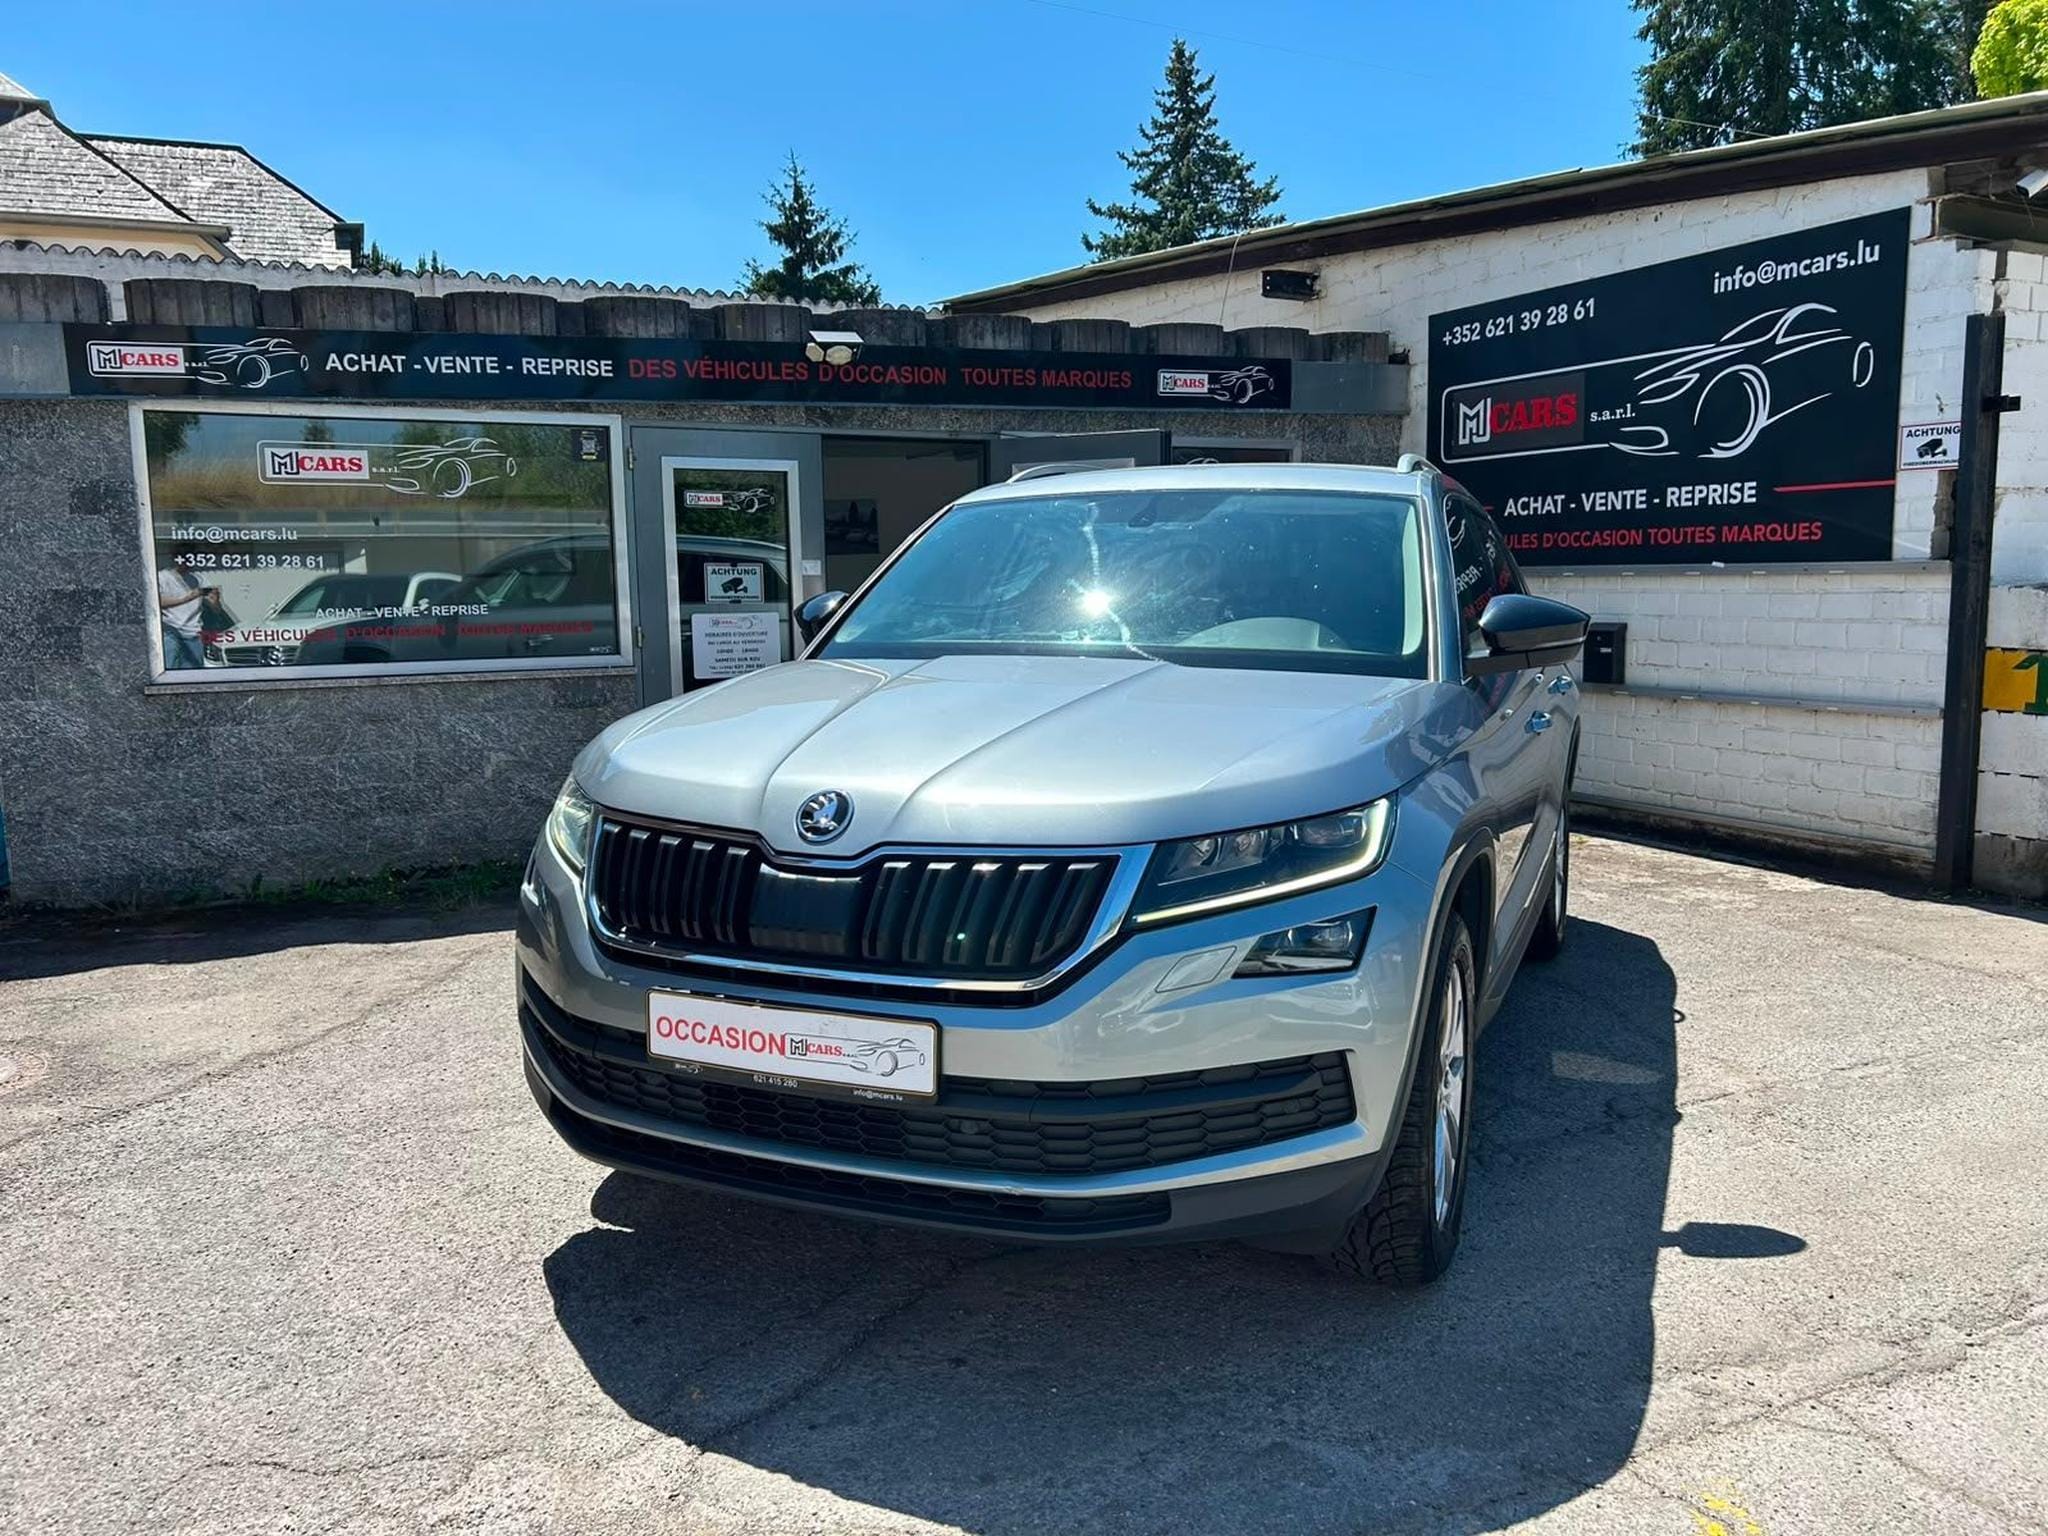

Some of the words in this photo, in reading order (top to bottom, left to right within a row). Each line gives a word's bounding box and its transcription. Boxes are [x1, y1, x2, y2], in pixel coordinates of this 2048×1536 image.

[1713, 239, 1880, 294] info@mcars.lu
[1443, 322, 1481, 346] +352
[1485, 314, 1514, 338] 621
[1520, 309, 1542, 331] 39
[1546, 303, 1568, 326] 28
[1573, 297, 1595, 320] 61
[325, 352, 406, 373] ACHAT
[521, 356, 614, 377] REPRISE
[628, 359, 677, 379] DES
[684, 354, 809, 381] VÉHICULES
[818, 363, 947, 385] D'OCCASION
[961, 367, 1037, 387] TOUTES
[1041, 370, 1133, 388] MARQUES
[1589, 403, 1636, 422] s.a.r.l.
[1906, 425, 1961, 439] ACHTUNG
[1504, 494, 1565, 517] ACHAT
[1581, 488, 1648, 512] VENTE
[1666, 481, 1758, 508] REPRISE
[171, 526, 298, 543] info@mcars.lu
[1542, 528, 1643, 549] D'OCCASION
[1649, 525, 1716, 545] TOUTES
[1721, 521, 1824, 544] MARQUES
[174, 553, 217, 568] +352
[221, 554, 250, 568] 621
[257, 554, 277, 568] 39
[281, 555, 301, 568] 28
[306, 555, 324, 569] 61
[710, 567, 758, 576] ACHTUNG
[315, 607, 362, 619] ACHAT
[431, 604, 489, 616] REPRISE
[656, 1015, 787, 1057] OCCASION
